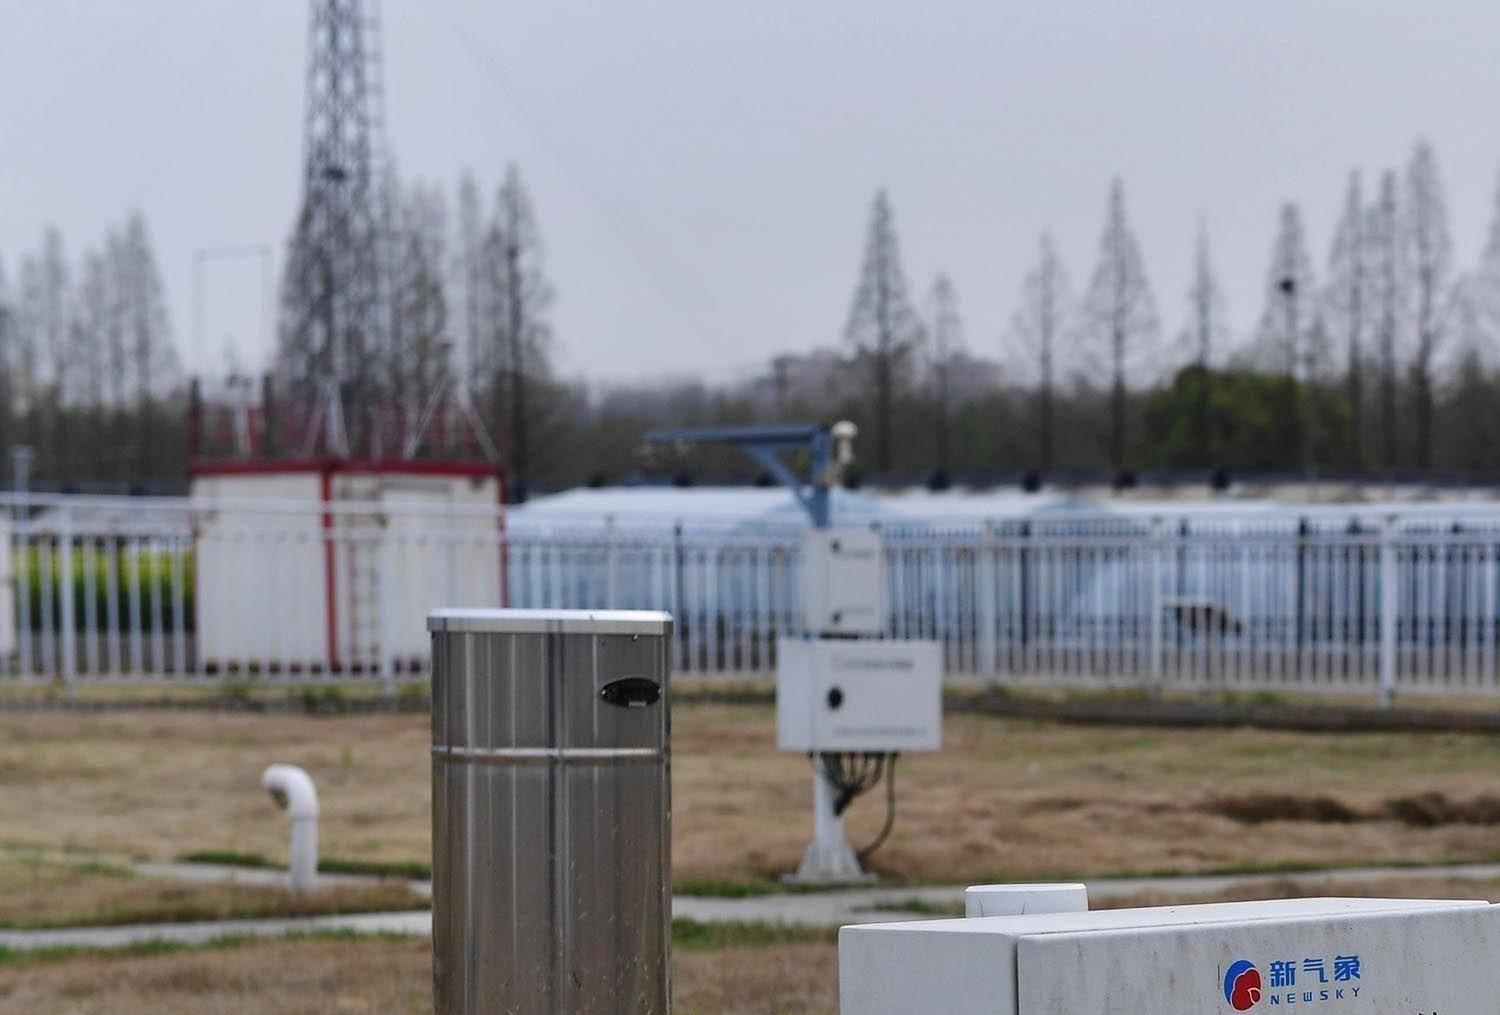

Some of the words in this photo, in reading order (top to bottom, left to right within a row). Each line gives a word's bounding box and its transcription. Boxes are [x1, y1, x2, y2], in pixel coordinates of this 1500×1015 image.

[1270, 955, 1361, 987] 新气象
[1270, 987, 1362, 1005] NEWSKY
